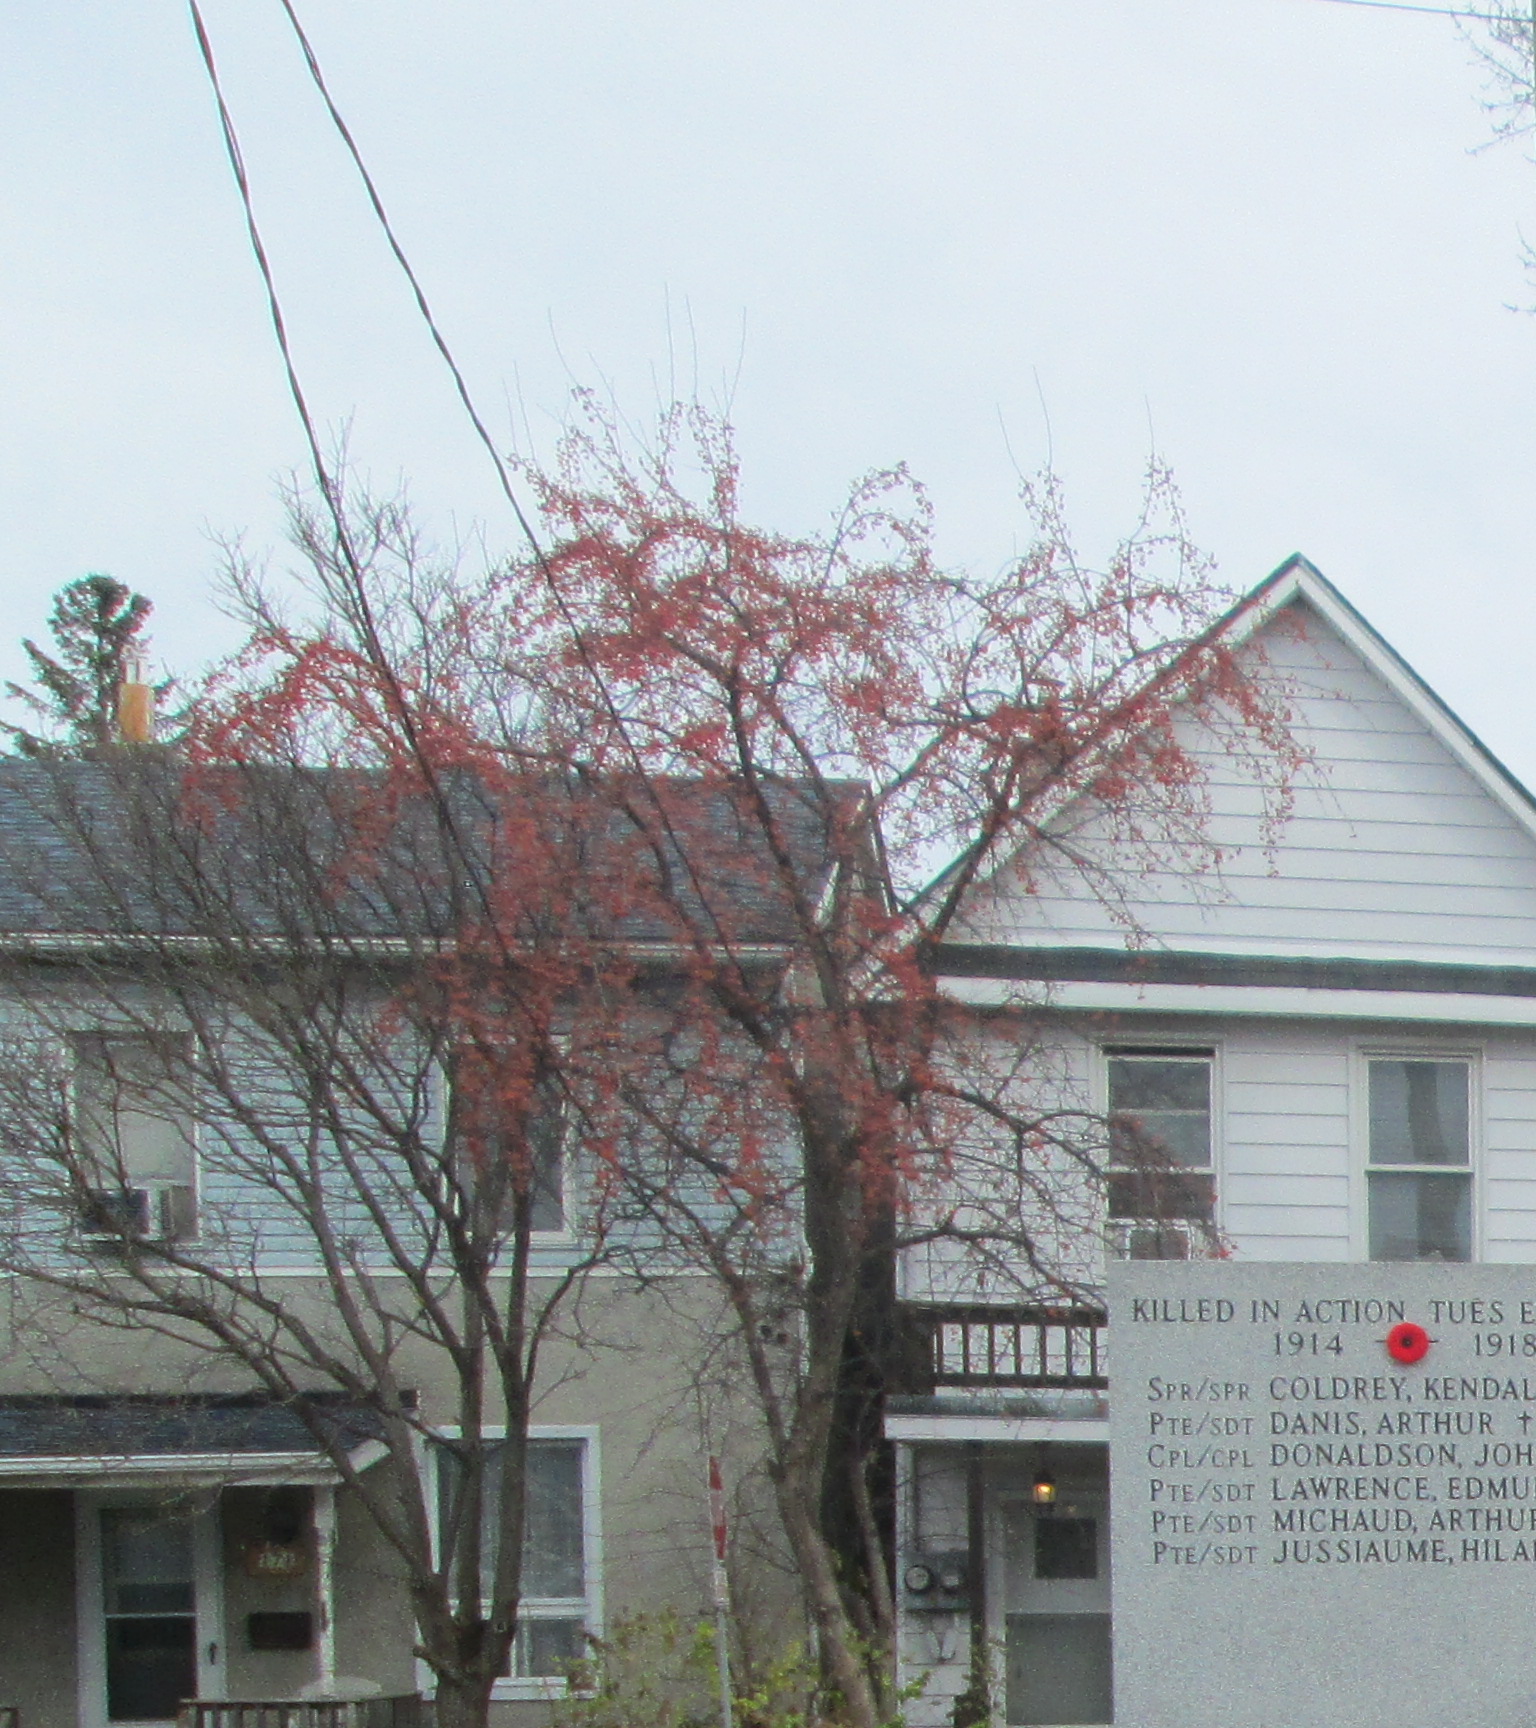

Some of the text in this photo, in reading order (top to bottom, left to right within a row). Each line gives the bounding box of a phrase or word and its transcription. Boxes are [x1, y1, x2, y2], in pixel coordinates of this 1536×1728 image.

[1132, 1299, 1234, 1323] KILLED
[1251, 1300, 1280, 1323] IN
[1295, 1300, 1406, 1323] ACTION
[1429, 1297, 1505, 1325] TUÉS
[1272, 1333, 1344, 1356] 1914
[1269, 1378, 1412, 1402] COLDREY,
[1270, 1412, 1494, 1437] DANIS, ARTHUR
[1270, 1444, 1463, 1469] DONALDSON,
[1273, 1509, 1418, 1534] MICHAUD,
[1273, 1540, 1453, 1565] JUSSIAUME,
